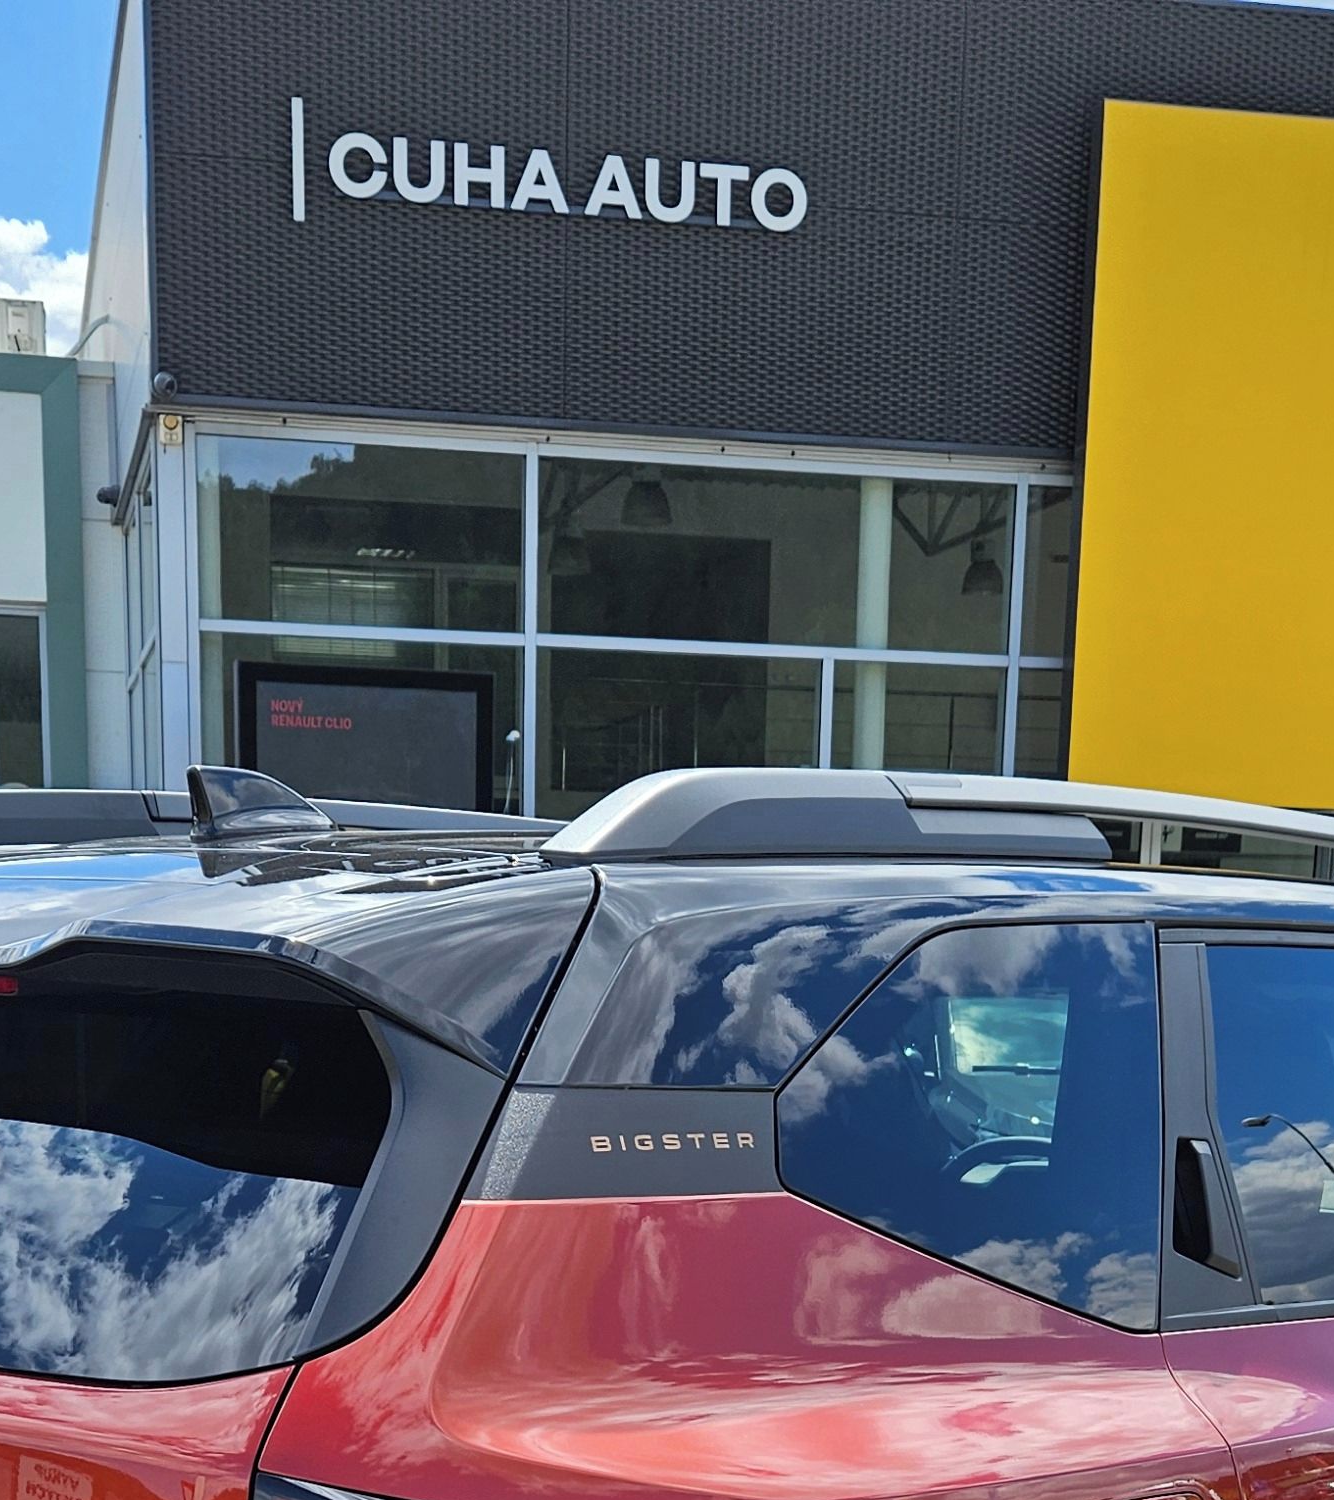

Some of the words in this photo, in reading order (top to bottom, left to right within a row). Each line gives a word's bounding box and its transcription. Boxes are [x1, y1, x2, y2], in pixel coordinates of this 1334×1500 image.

[328, 131, 569, 214] CUHA
[584, 154, 808, 232] AUTO
[270, 696, 304, 713] NOVÝ
[271, 714, 324, 729] RENAULT
[324, 715, 352, 730] CLIO
[589, 1130, 756, 1153] BIGSTER
